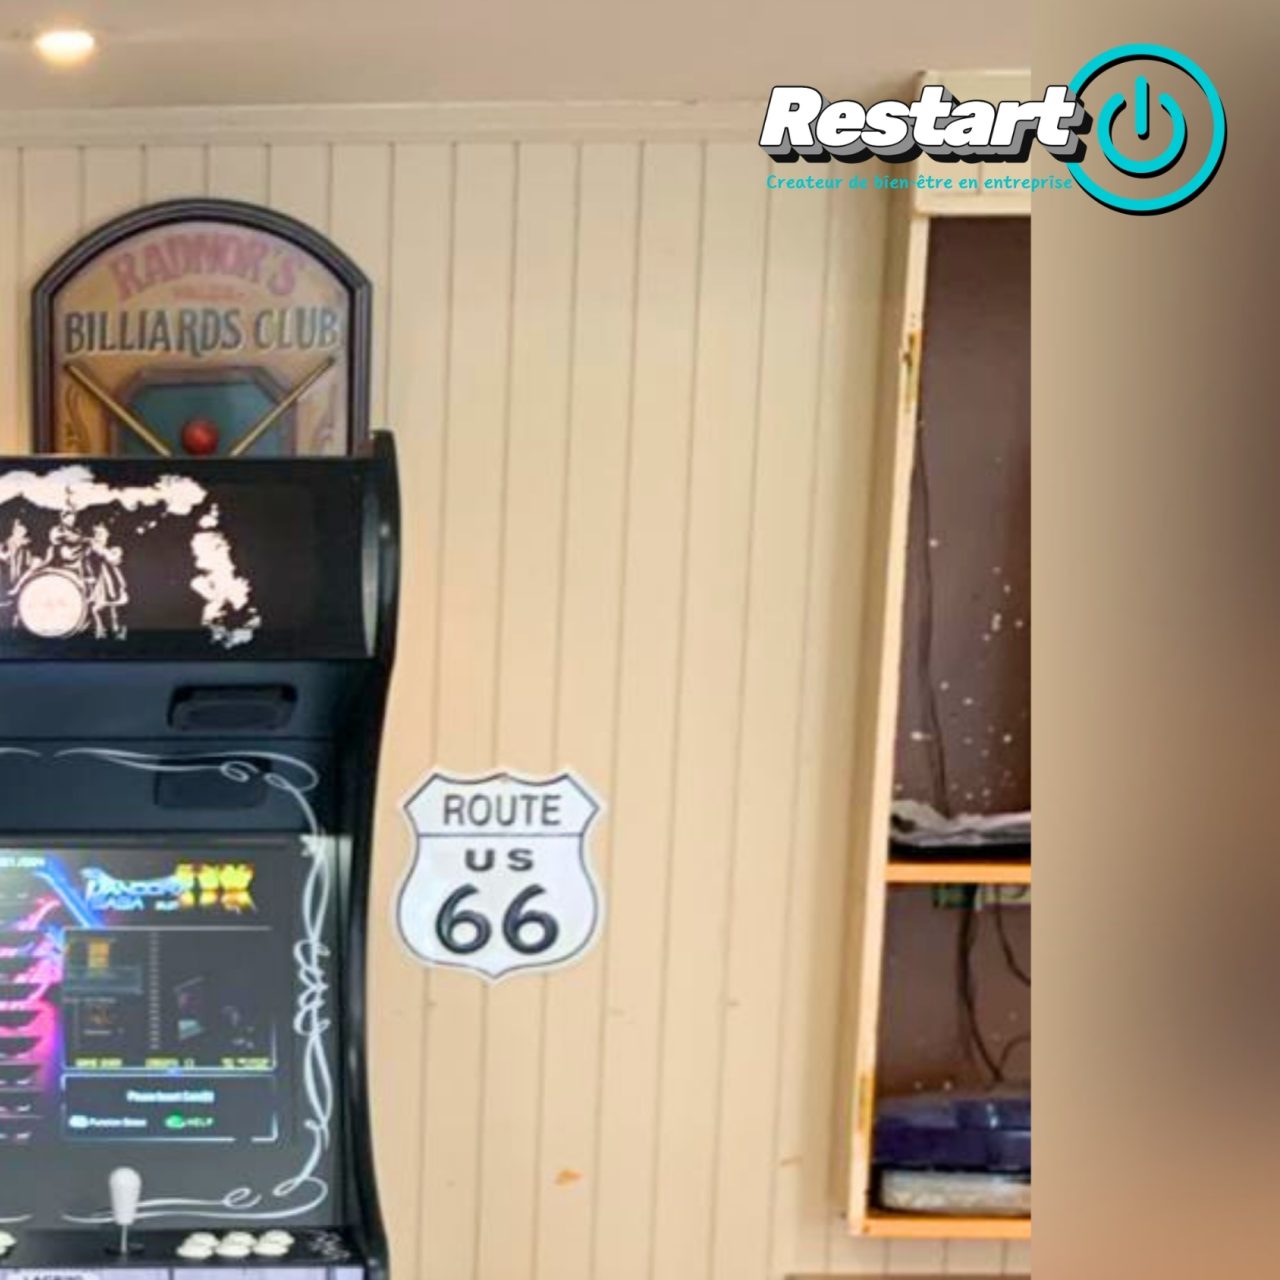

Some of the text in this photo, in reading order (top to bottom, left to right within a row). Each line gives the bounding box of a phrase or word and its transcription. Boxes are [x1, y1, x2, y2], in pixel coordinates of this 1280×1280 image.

[65, 307, 338, 357] BILLIARDS CLUB
[443, 794, 562, 826] ROUTE
[464, 848, 535, 872] US
[435, 883, 560, 956] 66
